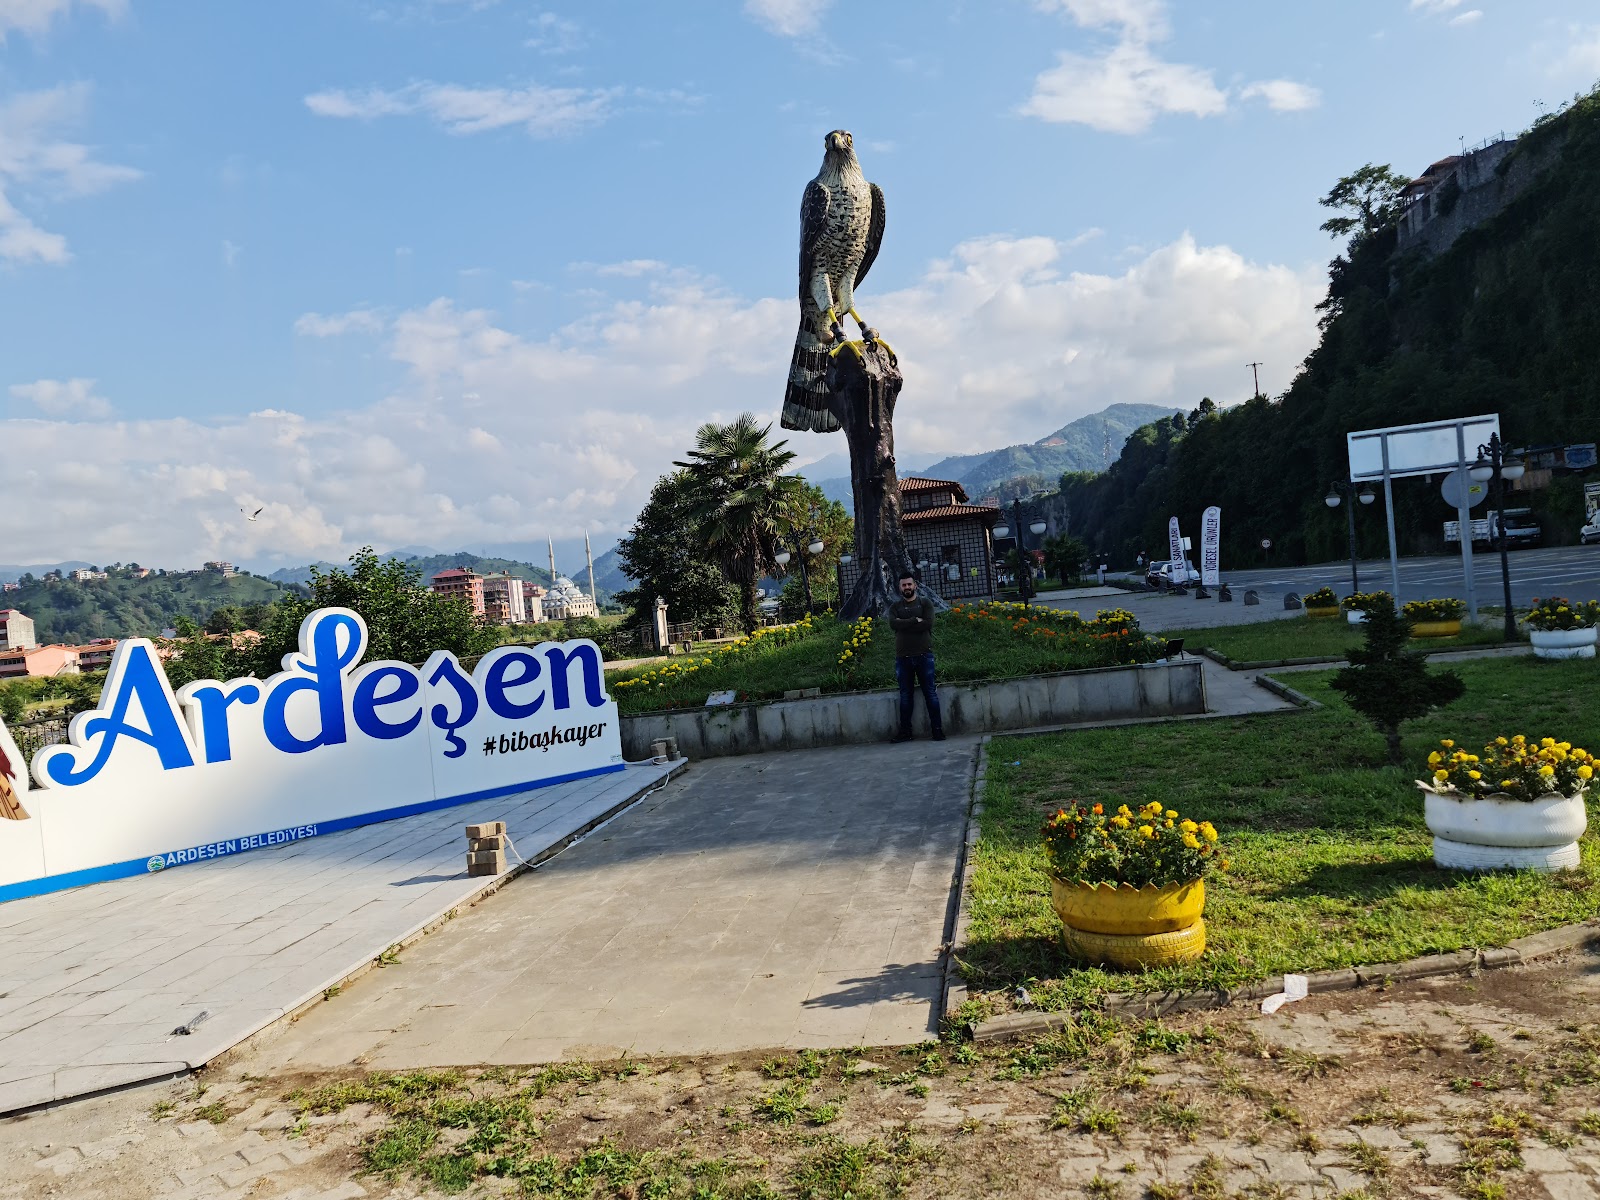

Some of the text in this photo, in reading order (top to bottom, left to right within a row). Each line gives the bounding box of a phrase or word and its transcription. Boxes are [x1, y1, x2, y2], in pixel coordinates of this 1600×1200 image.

[1171, 527, 1184, 570] EL SANATLARI
[1204, 518, 1218, 572] YÖRESEL ÜRÜNLER
[47, 613, 607, 787] Ardeşen
[482, 722, 607, 756] #bibaşkayer
[165, 840, 236, 867] ARDEŞEN
